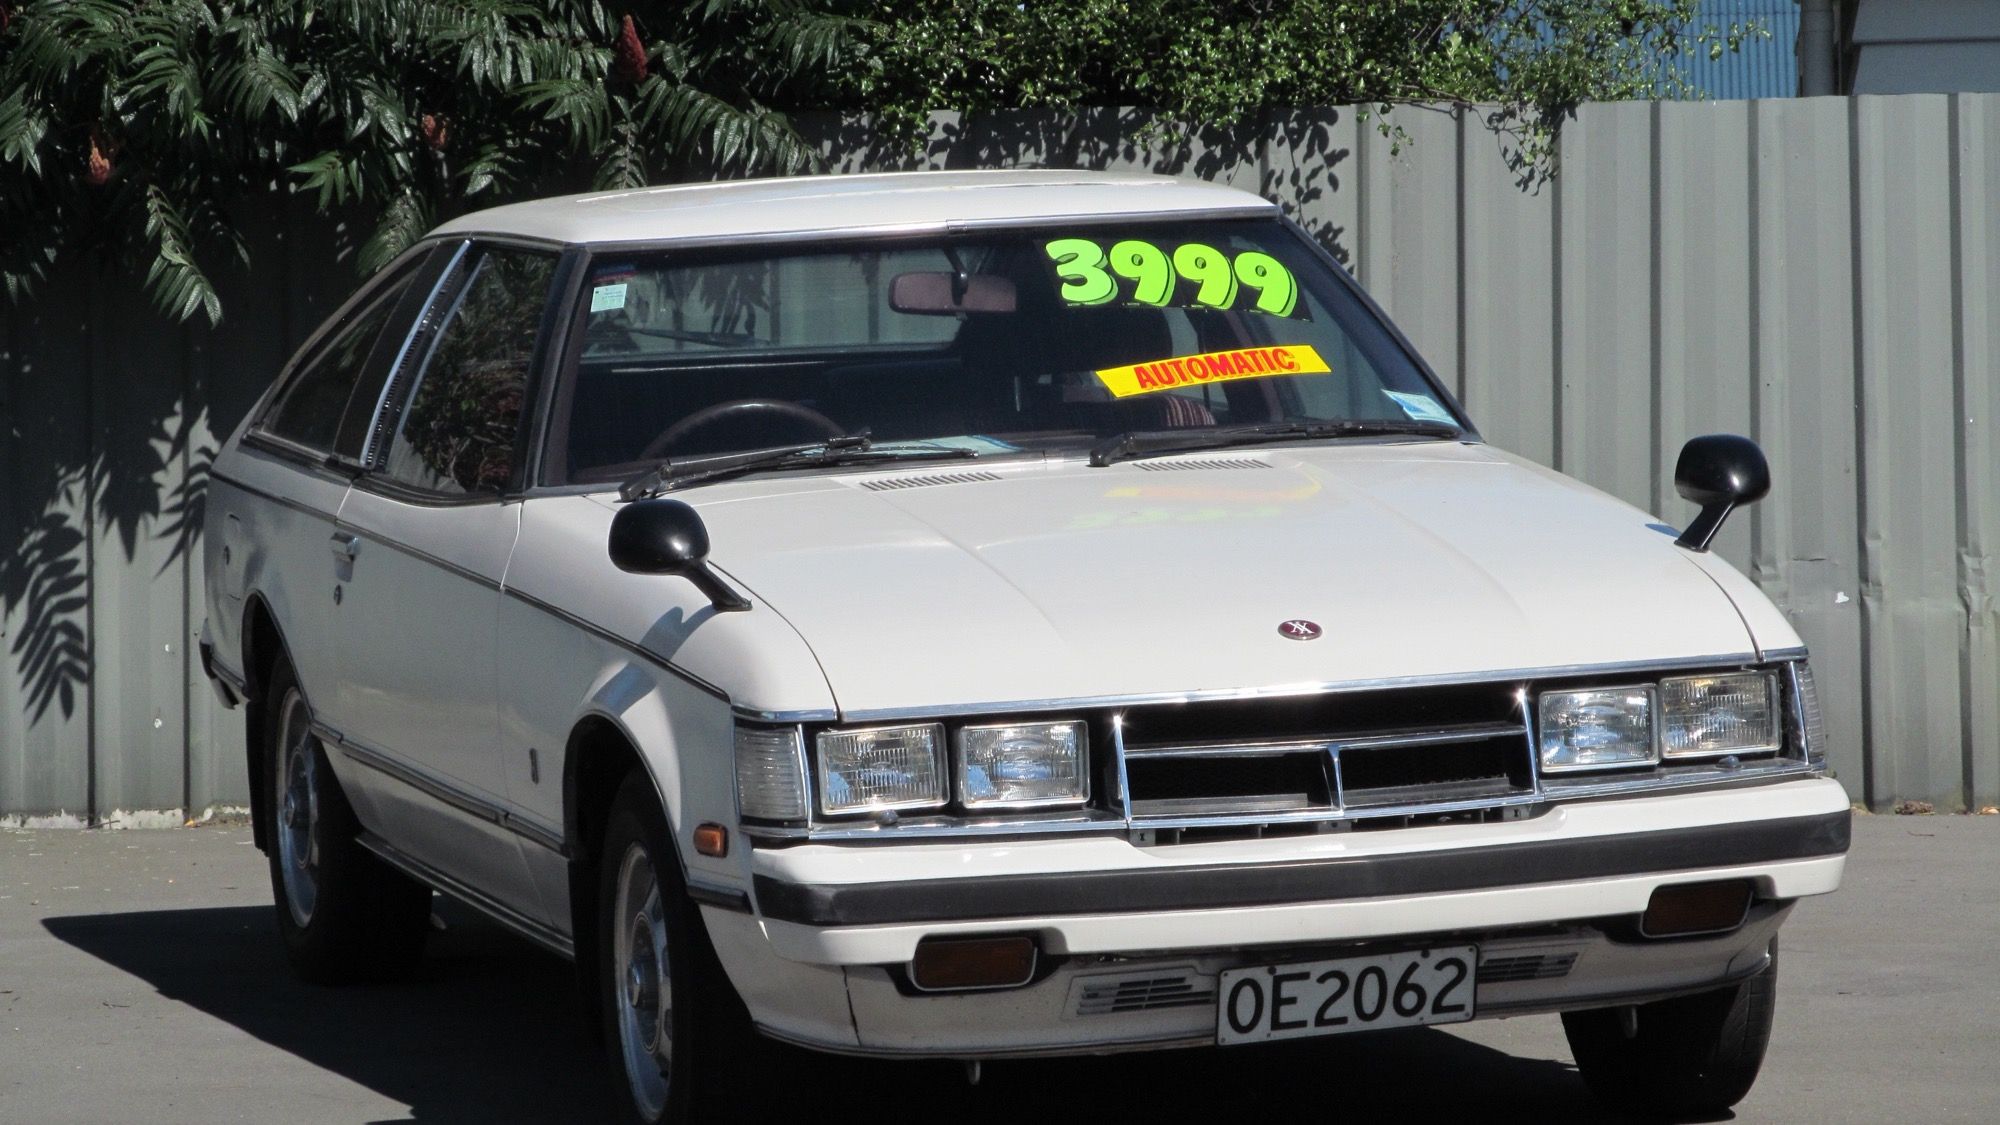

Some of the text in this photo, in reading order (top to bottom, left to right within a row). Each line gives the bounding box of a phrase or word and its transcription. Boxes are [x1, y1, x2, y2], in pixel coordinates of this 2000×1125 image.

[1045, 238, 1298, 318] 3999
[1133, 348, 1300, 389] AUTOMATIC
[1227, 957, 1467, 1034] OE2062
